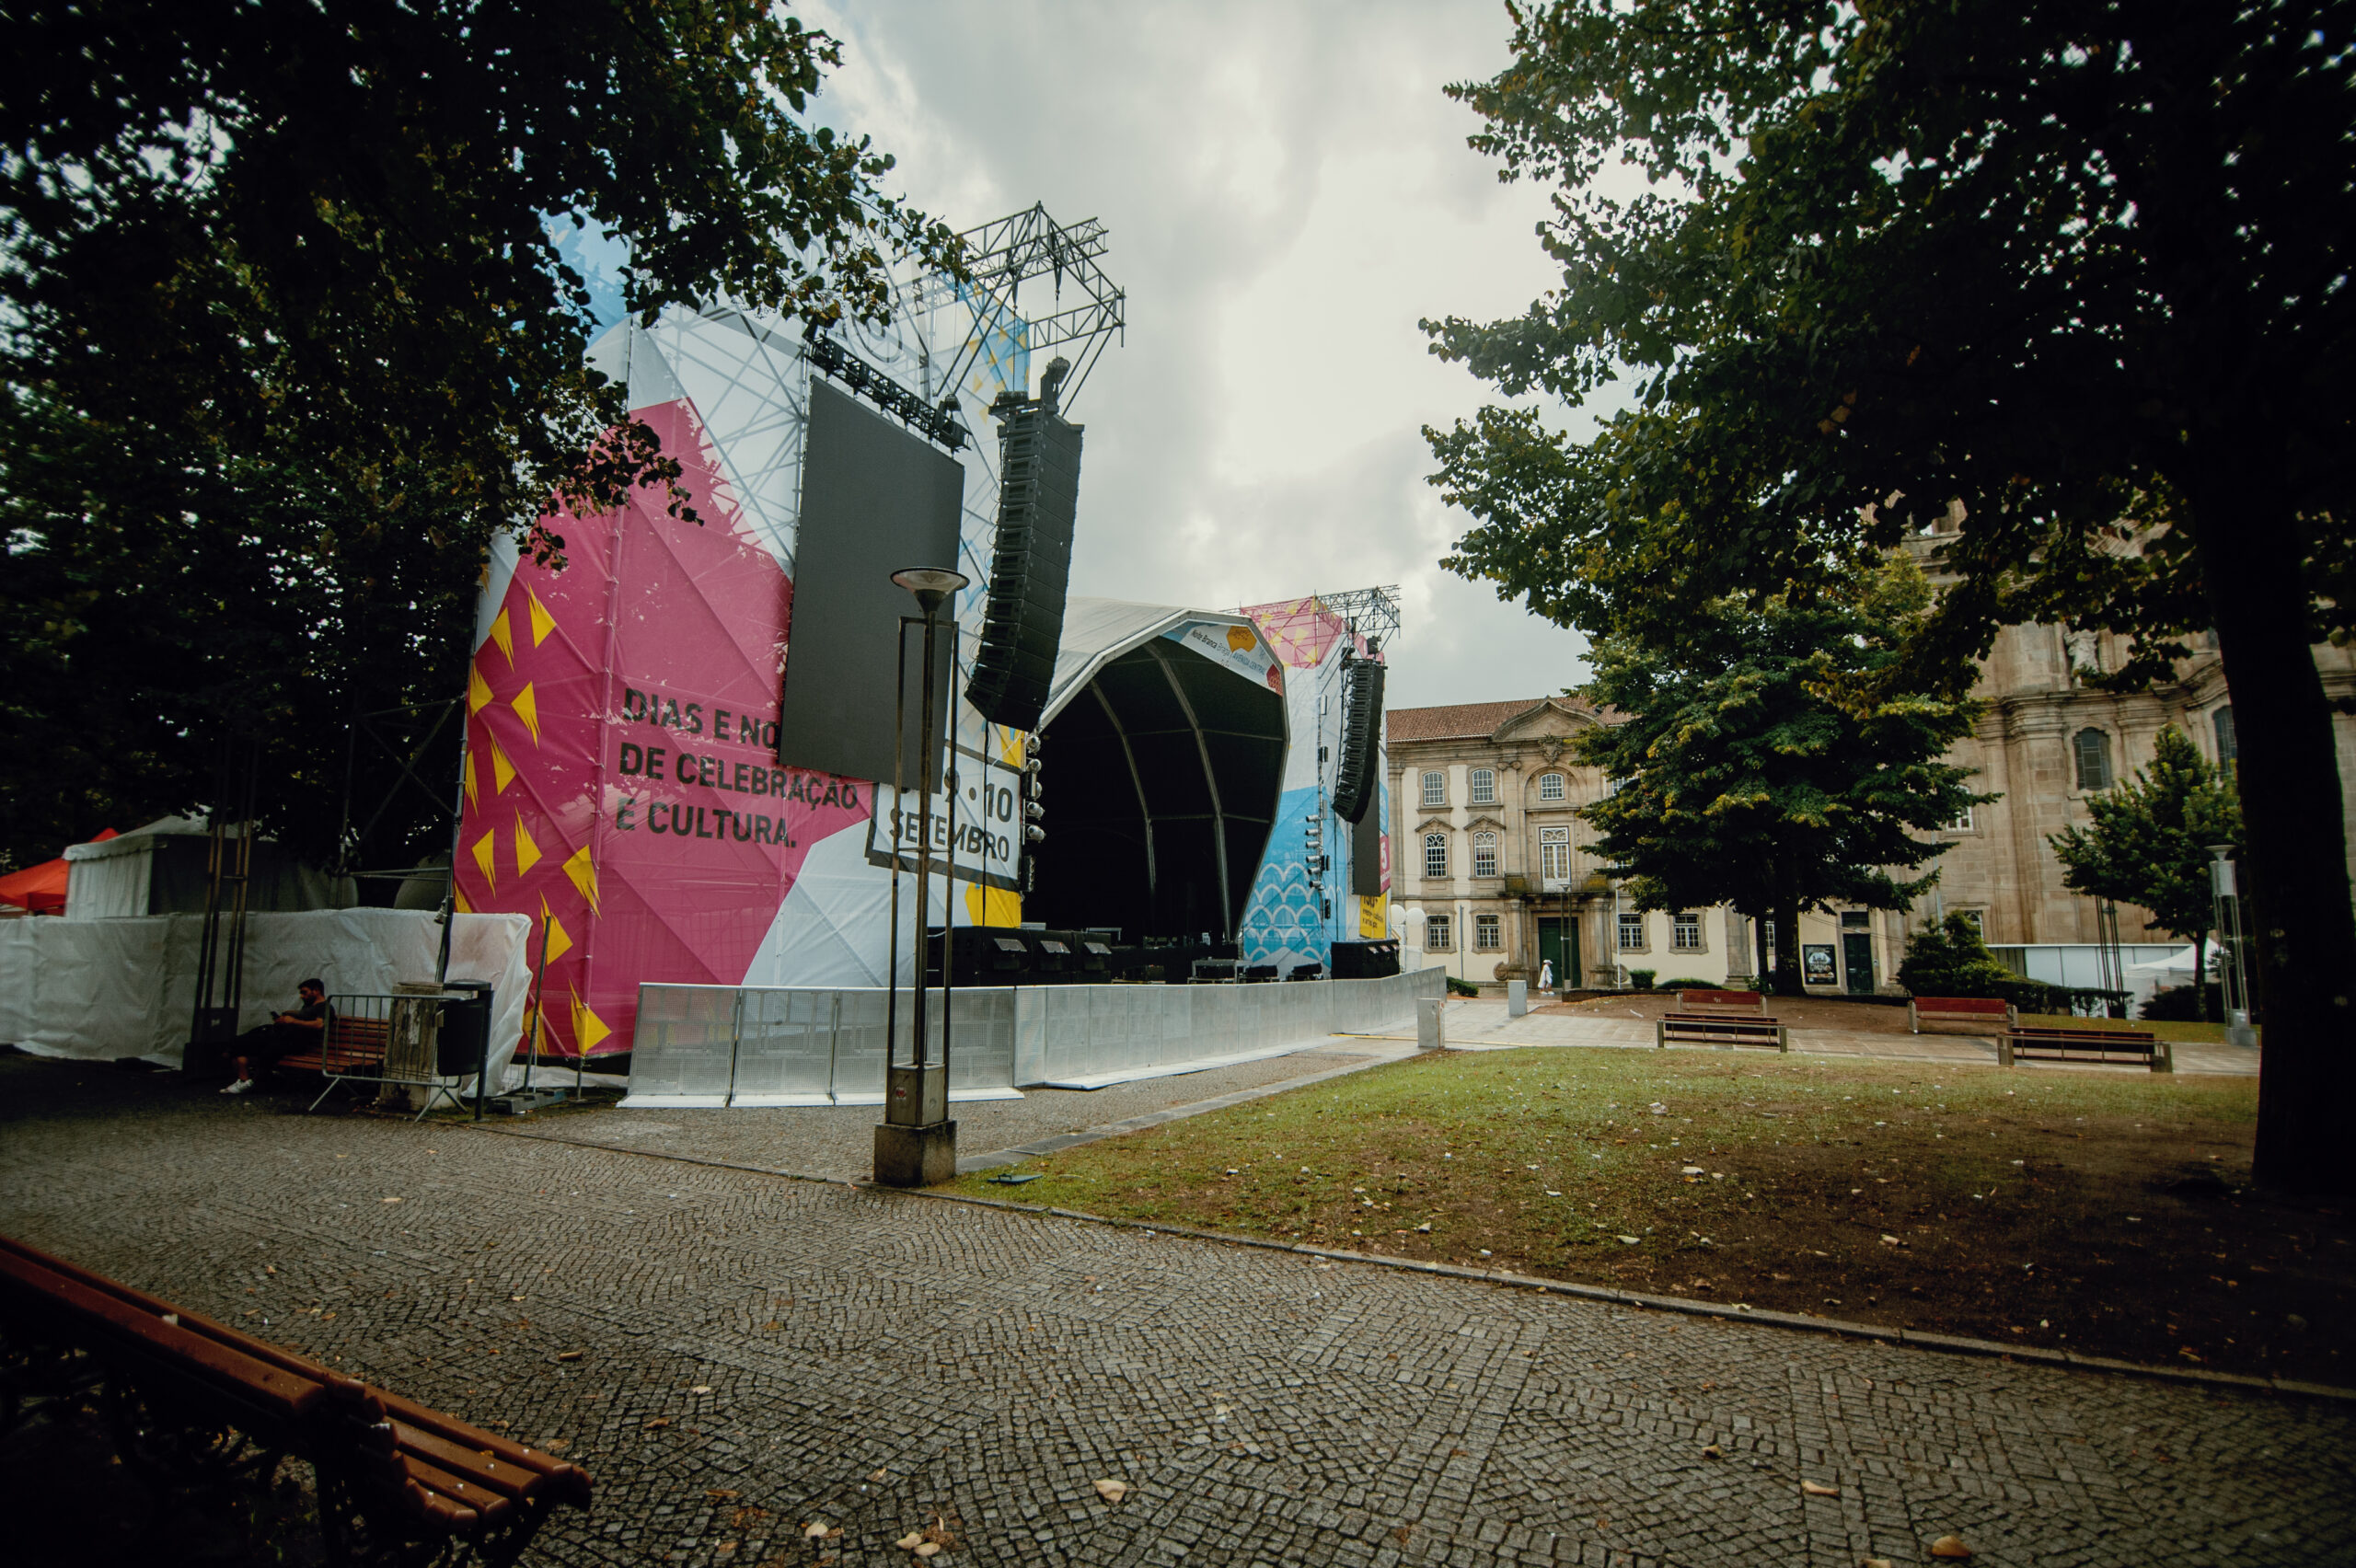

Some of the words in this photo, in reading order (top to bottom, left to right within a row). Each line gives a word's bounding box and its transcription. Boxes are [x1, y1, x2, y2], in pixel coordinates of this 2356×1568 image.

[623, 688, 703, 734] DIAS
[714, 709, 731, 741] E
[619, 742, 665, 780] DE
[676, 753, 858, 811] CELEBRAÇÃO
[986, 782, 1012, 823] 10
[616, 797, 637, 831] E
[648, 801, 797, 848] CULTURA.
